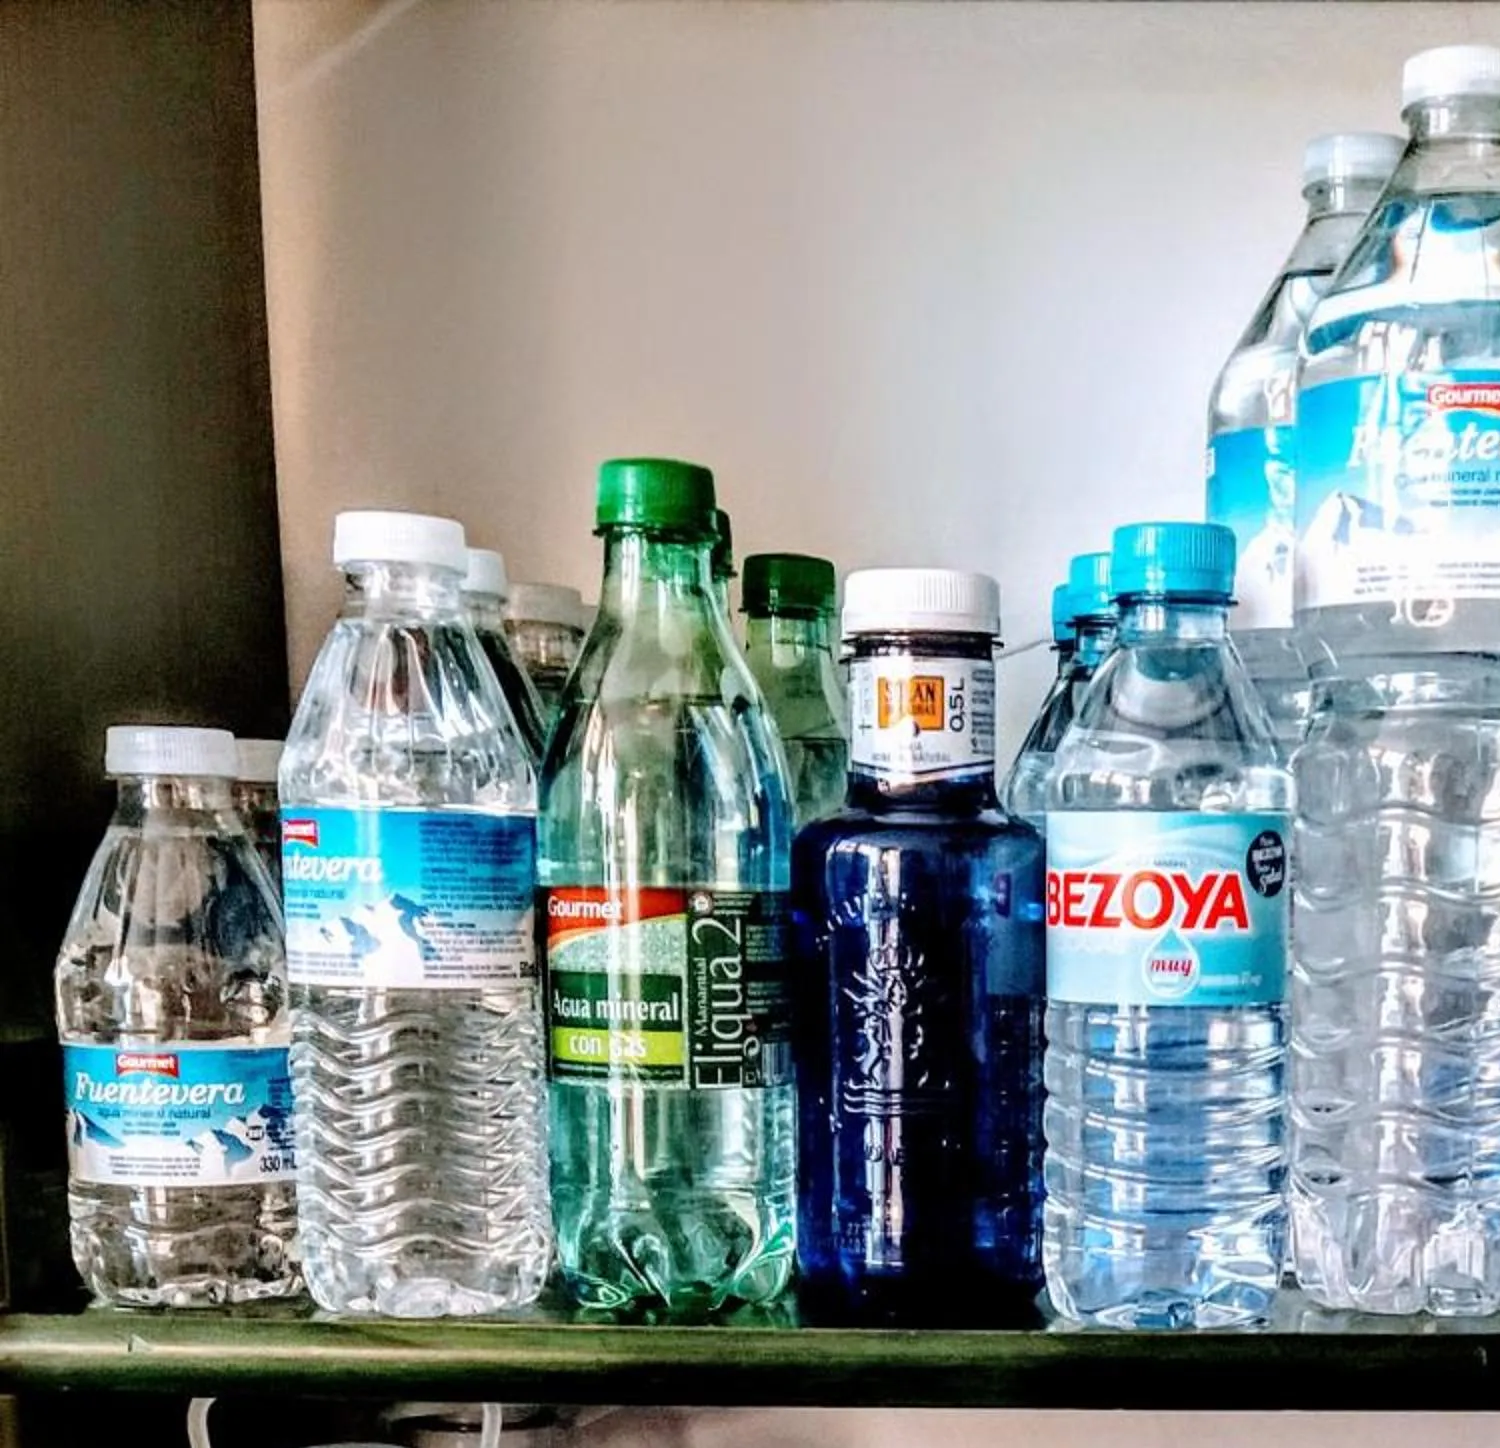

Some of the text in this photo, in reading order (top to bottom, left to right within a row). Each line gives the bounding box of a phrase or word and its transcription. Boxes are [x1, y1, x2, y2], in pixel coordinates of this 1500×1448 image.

[548, 896, 623, 919] Gourmet
[1046, 870, 1250, 930] BEZOYA
[691, 917, 742, 946] 2
[1150, 958, 1193, 977] muy
[553, 989, 680, 1021] Agua mineral
[691, 953, 753, 1090] Eliqua
[570, 1033, 602, 1055] con
[117, 1055, 176, 1071] Gourmet
[75, 1071, 246, 1106] Fuentevera
[259, 1155, 281, 1174] 330
